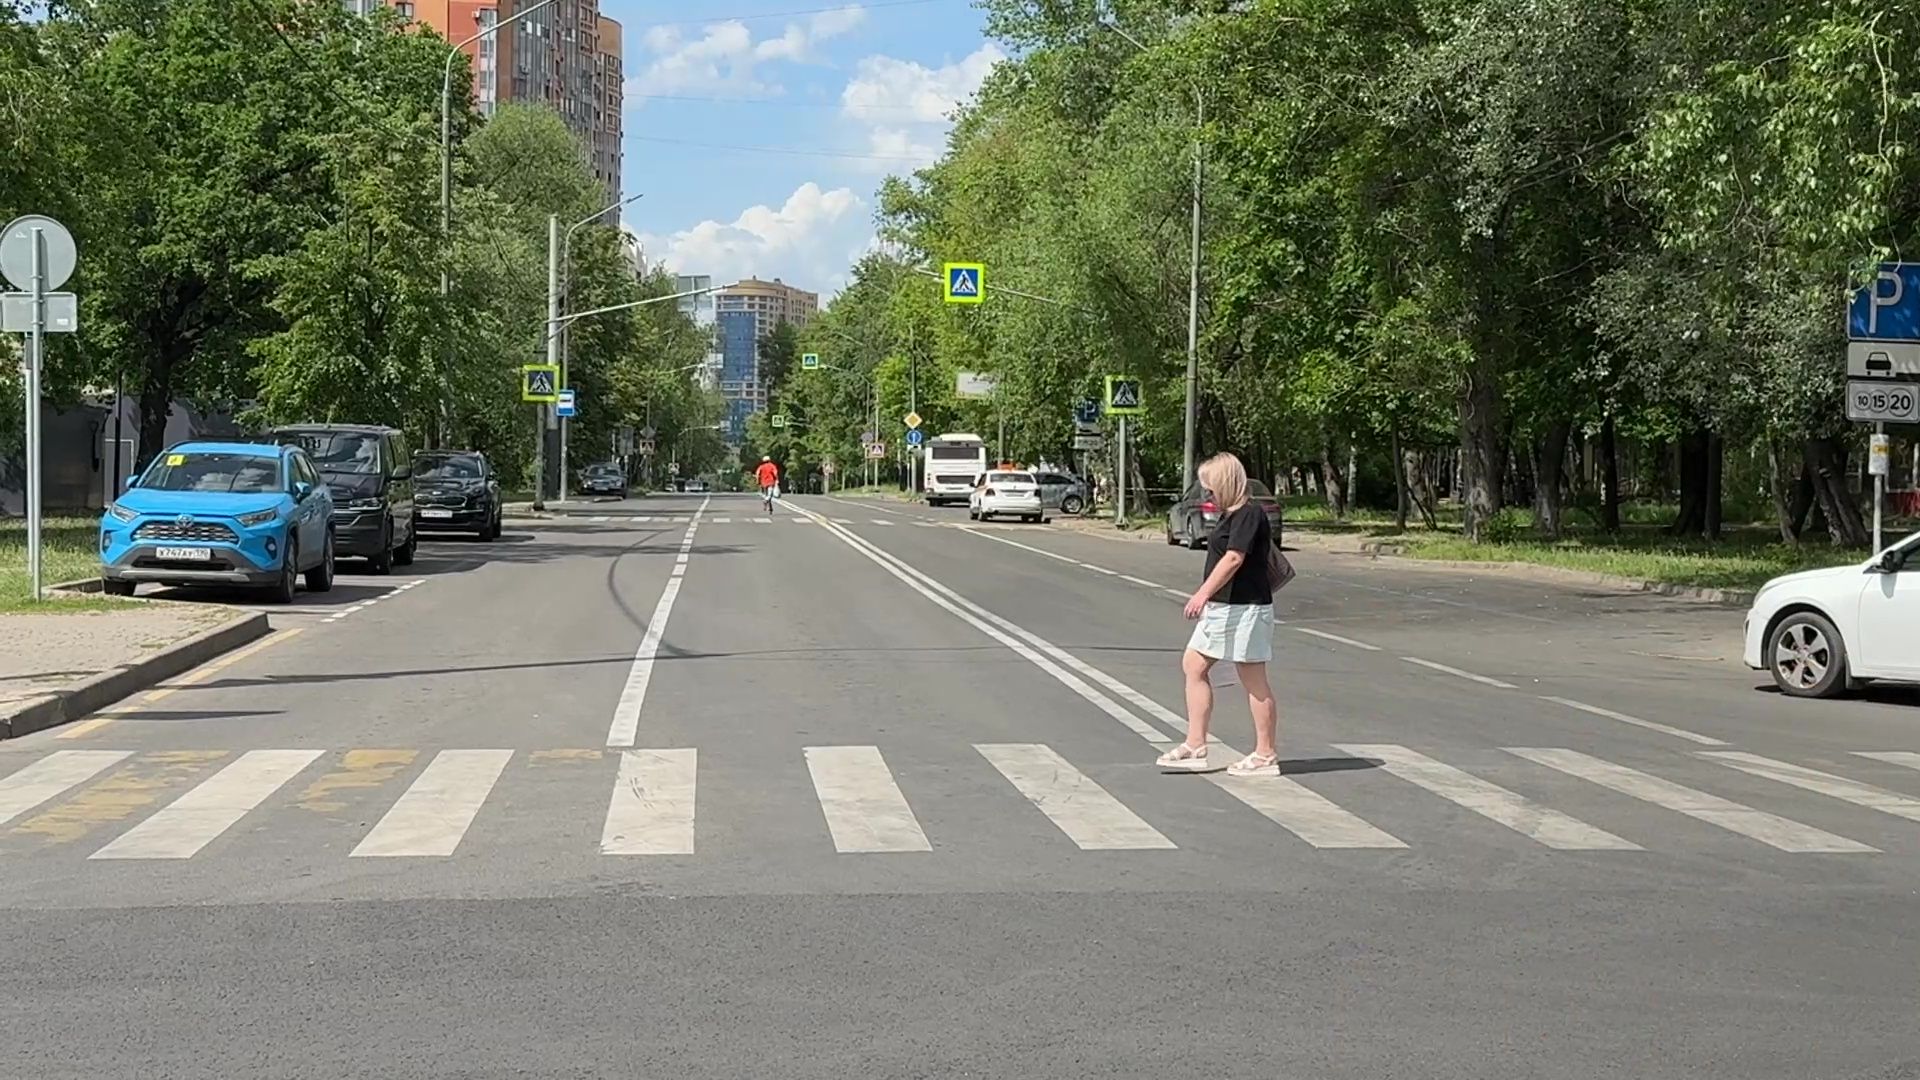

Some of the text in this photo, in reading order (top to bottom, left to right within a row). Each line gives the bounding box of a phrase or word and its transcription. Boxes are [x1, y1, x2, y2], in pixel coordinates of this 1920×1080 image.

[1869, 271, 1903, 333] P
[1858, 394, 1911, 410] 10 15 20
